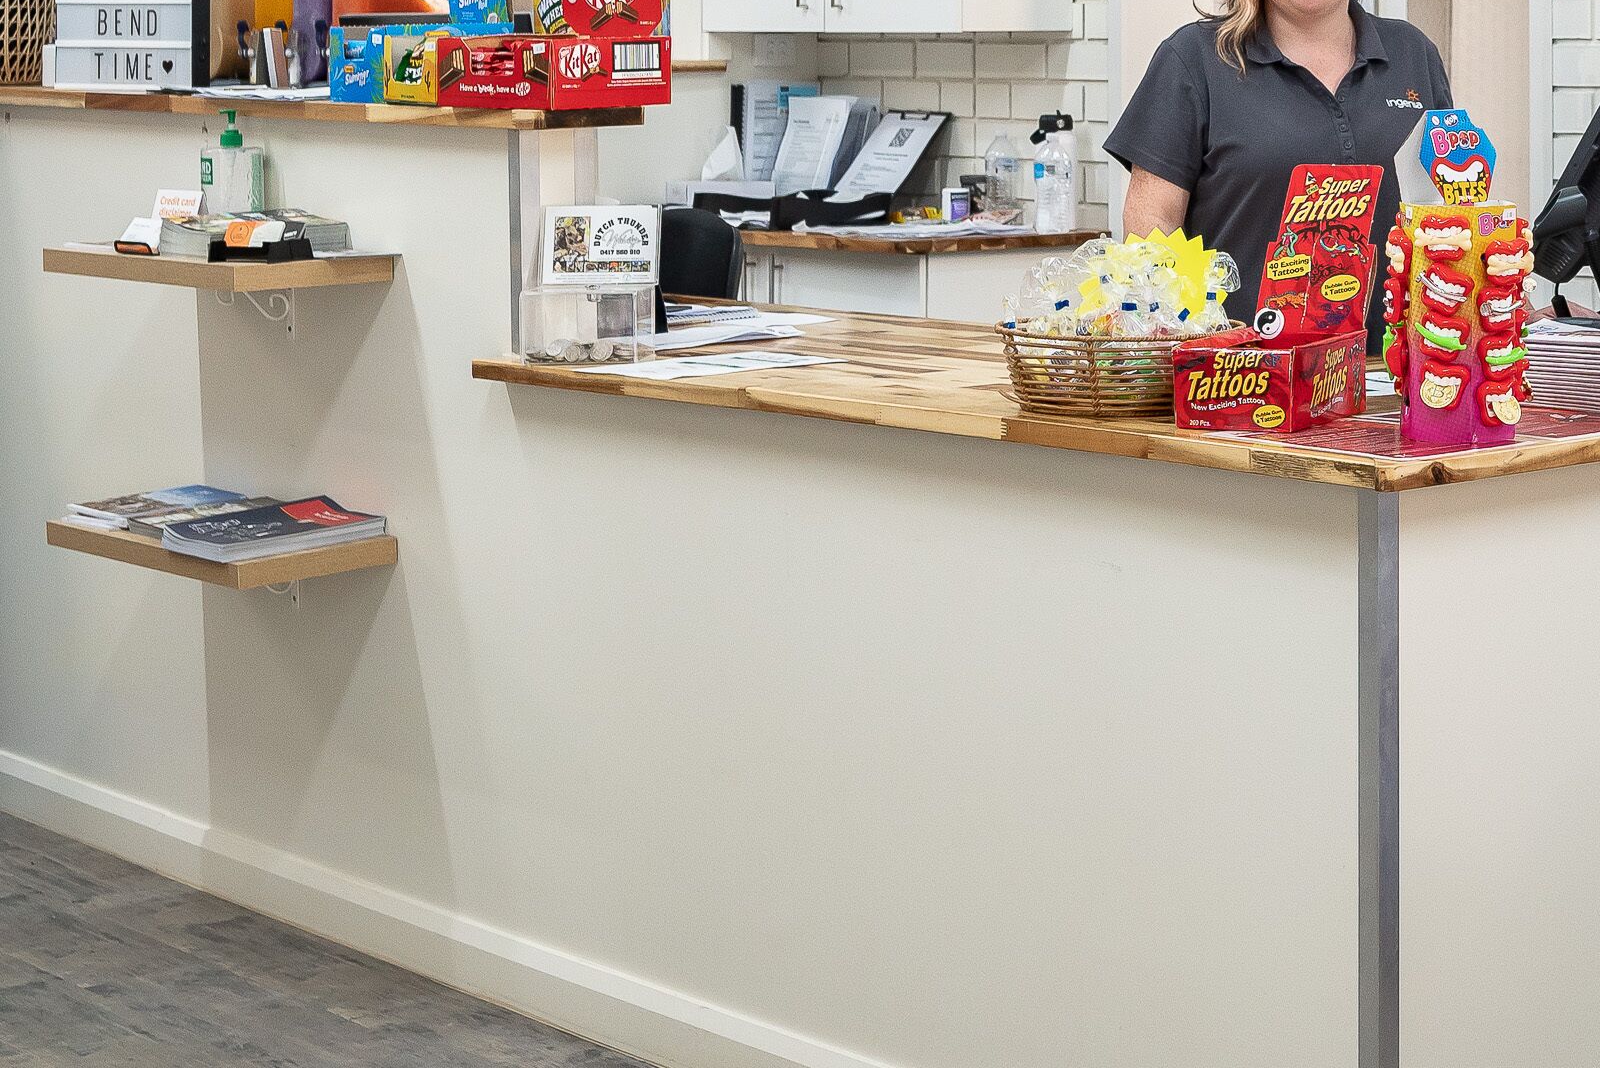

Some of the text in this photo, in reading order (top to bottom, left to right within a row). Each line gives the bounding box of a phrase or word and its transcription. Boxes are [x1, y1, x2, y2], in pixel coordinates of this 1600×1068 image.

[97, 8, 158, 37] BEND
[94, 52, 153, 81] TIME
[563, 43, 600, 79] KitKat
[459, 83, 473, 92] Have
[496, 84, 510, 93] have
[1318, 176, 1371, 197] Super
[160, 195, 196, 207] Credit card
[1284, 194, 1371, 225] Tattoos
[593, 218, 615, 247] DUTCH
[617, 217, 649, 246] THUNDER
[1268, 257, 1310, 270] 40 Exciting
[1271, 267, 1305, 278] Tattoos
[1329, 285, 1356, 295] Tattoos
[1213, 351, 1265, 372] Super
[1324, 346, 1347, 371] Super
[1187, 371, 1270, 401] Tattoos
[1310, 365, 1348, 409] Tattoos
[1190, 397, 1266, 412] New Exciting Tattoos
